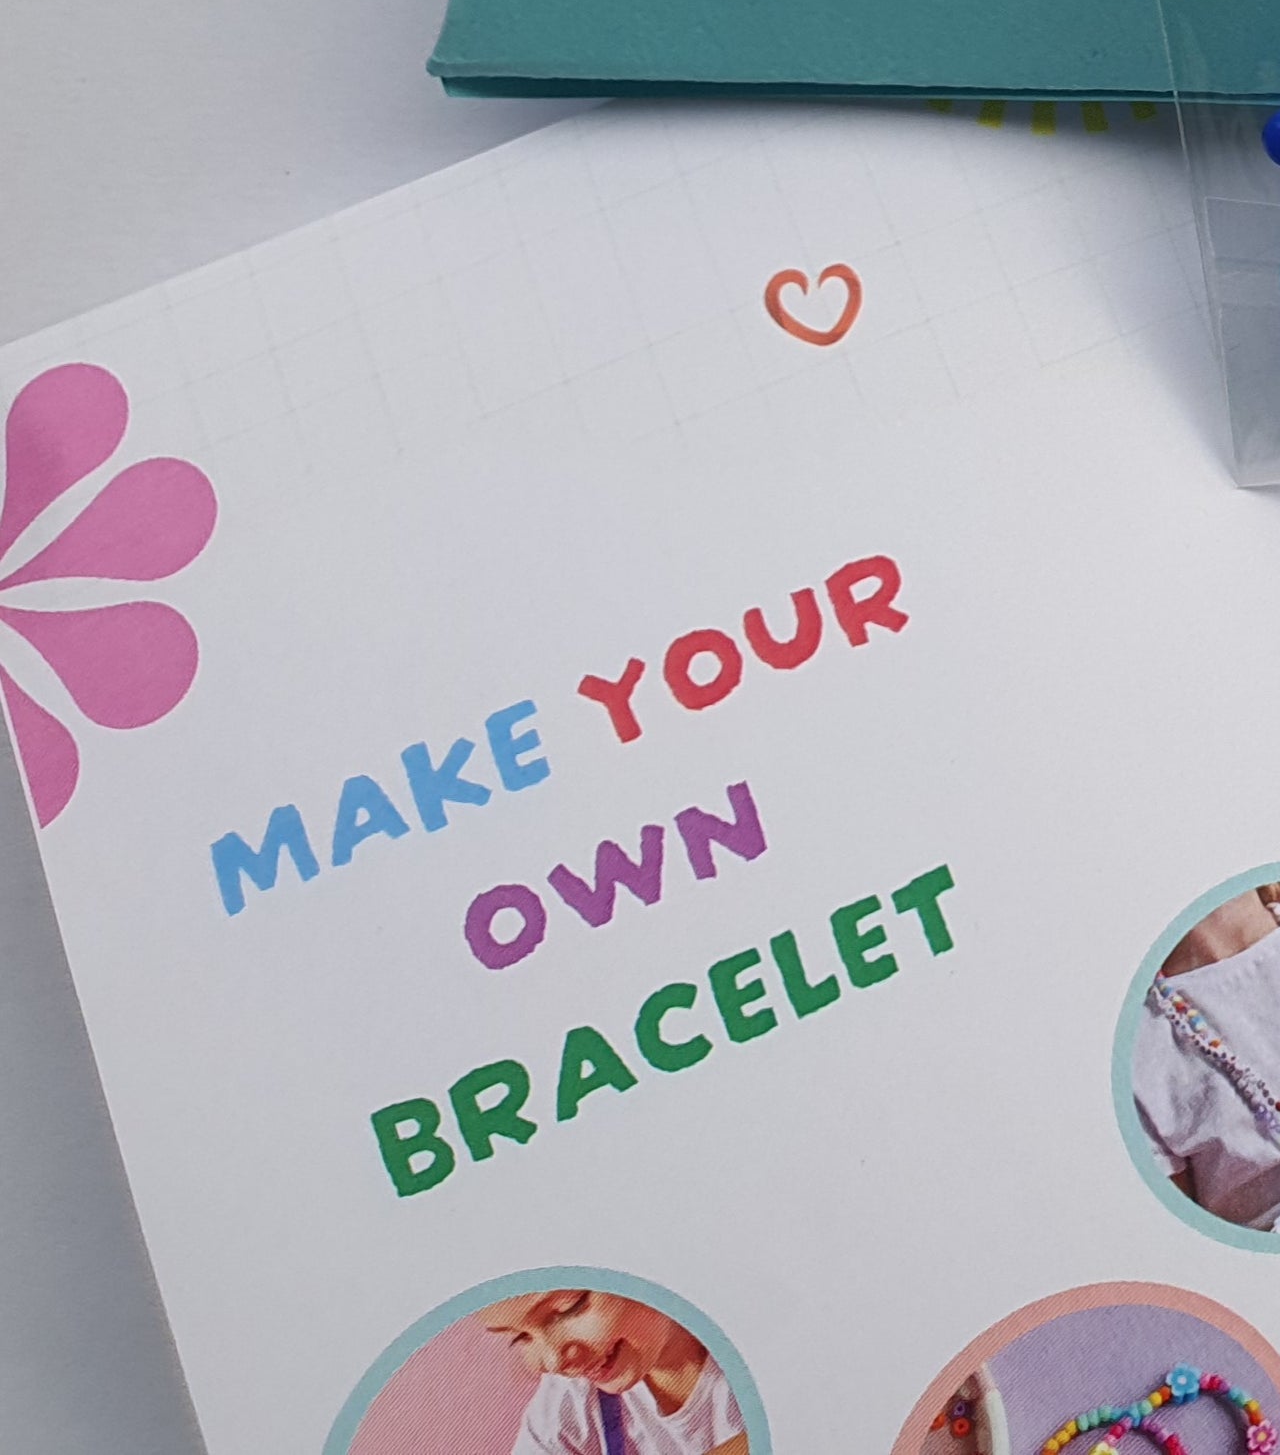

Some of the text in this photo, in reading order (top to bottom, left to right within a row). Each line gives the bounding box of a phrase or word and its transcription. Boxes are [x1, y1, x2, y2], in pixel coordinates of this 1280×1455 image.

[209, 554, 910, 917] MAKE YOUR
[463, 780, 769, 970] OWN
[370, 863, 957, 1198] BRACELET
